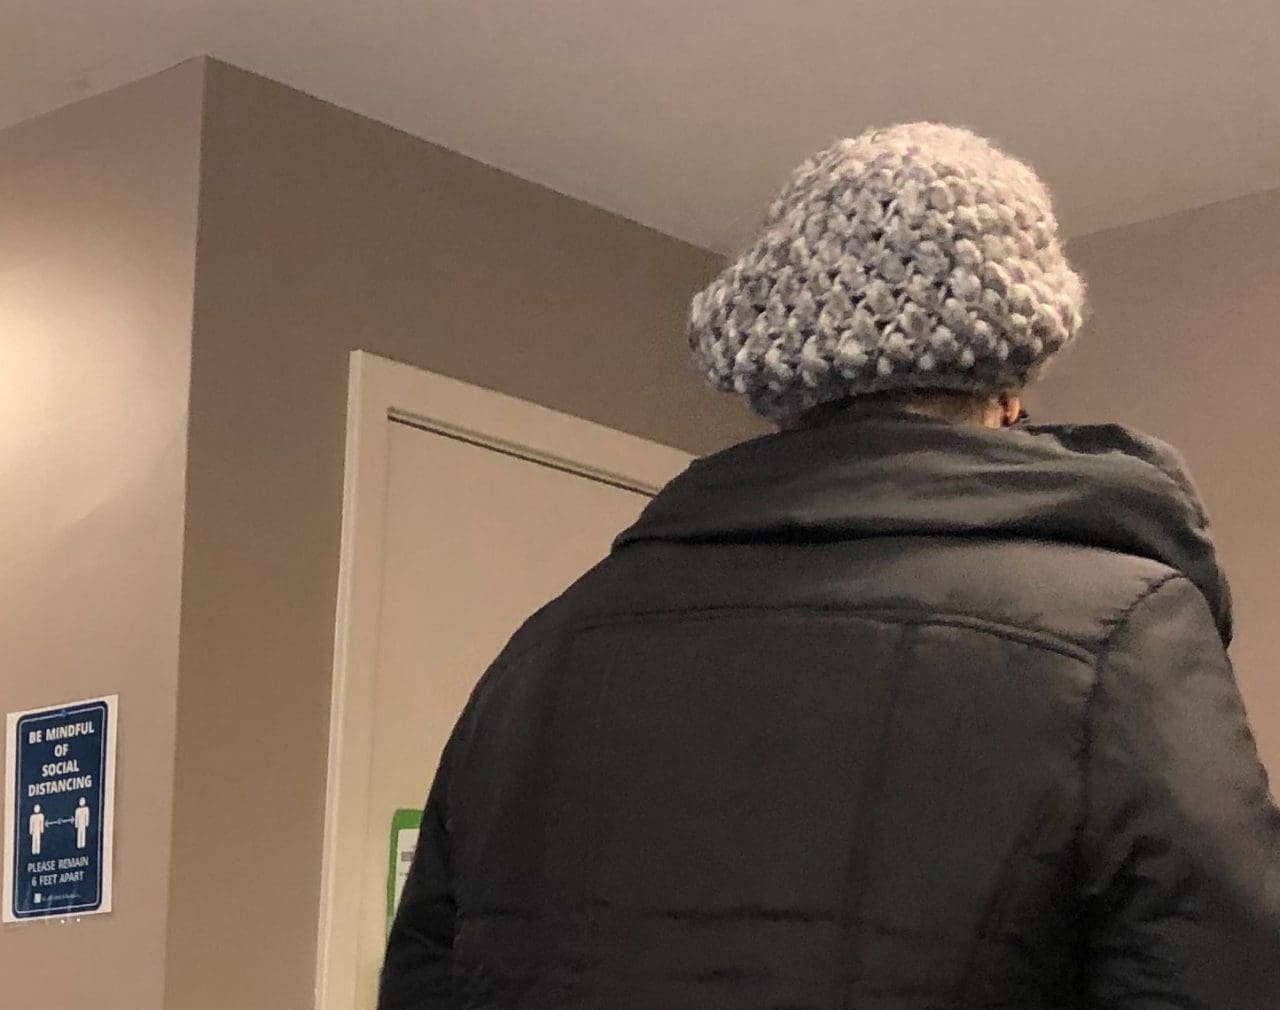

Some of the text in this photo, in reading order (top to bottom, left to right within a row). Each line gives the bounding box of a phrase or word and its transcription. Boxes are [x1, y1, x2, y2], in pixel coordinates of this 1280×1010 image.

[29, 721, 95, 744] BE MINDFUL
[54, 743, 69, 757] OF
[42, 760, 80, 777] SOCIAL
[28, 775, 92, 797] DISTANCING
[27, 856, 89, 872] PLEASE REMAIN
[31, 871, 84, 887] 6 FEET APART
